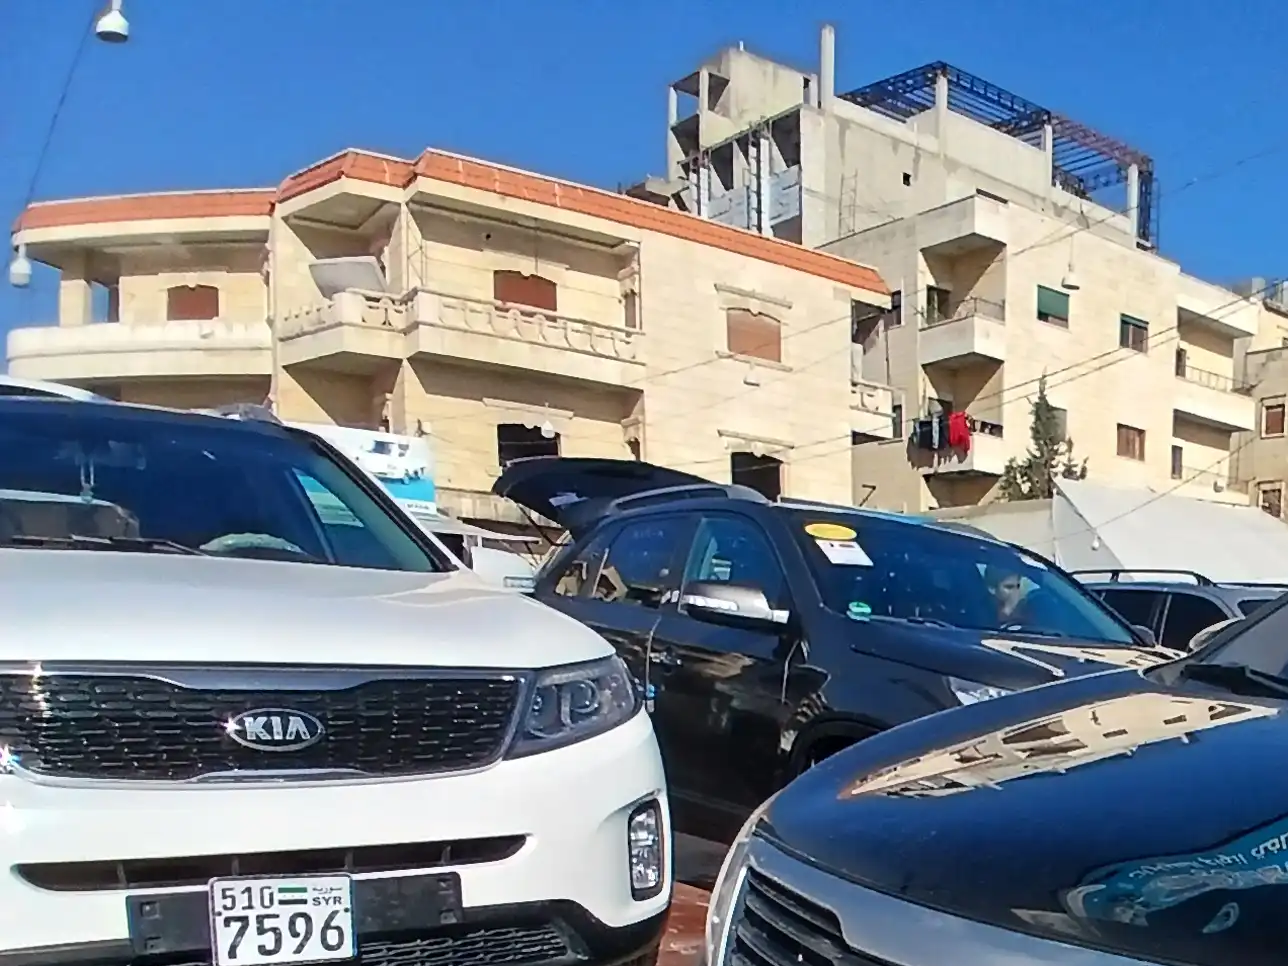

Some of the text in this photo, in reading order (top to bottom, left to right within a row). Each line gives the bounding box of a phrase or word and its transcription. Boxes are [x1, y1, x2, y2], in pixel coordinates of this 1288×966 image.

[243, 716, 311, 740] KIA
[221, 886, 274, 911] 510
[312, 896, 343, 906] SYR
[223, 910, 345, 959] 7596
